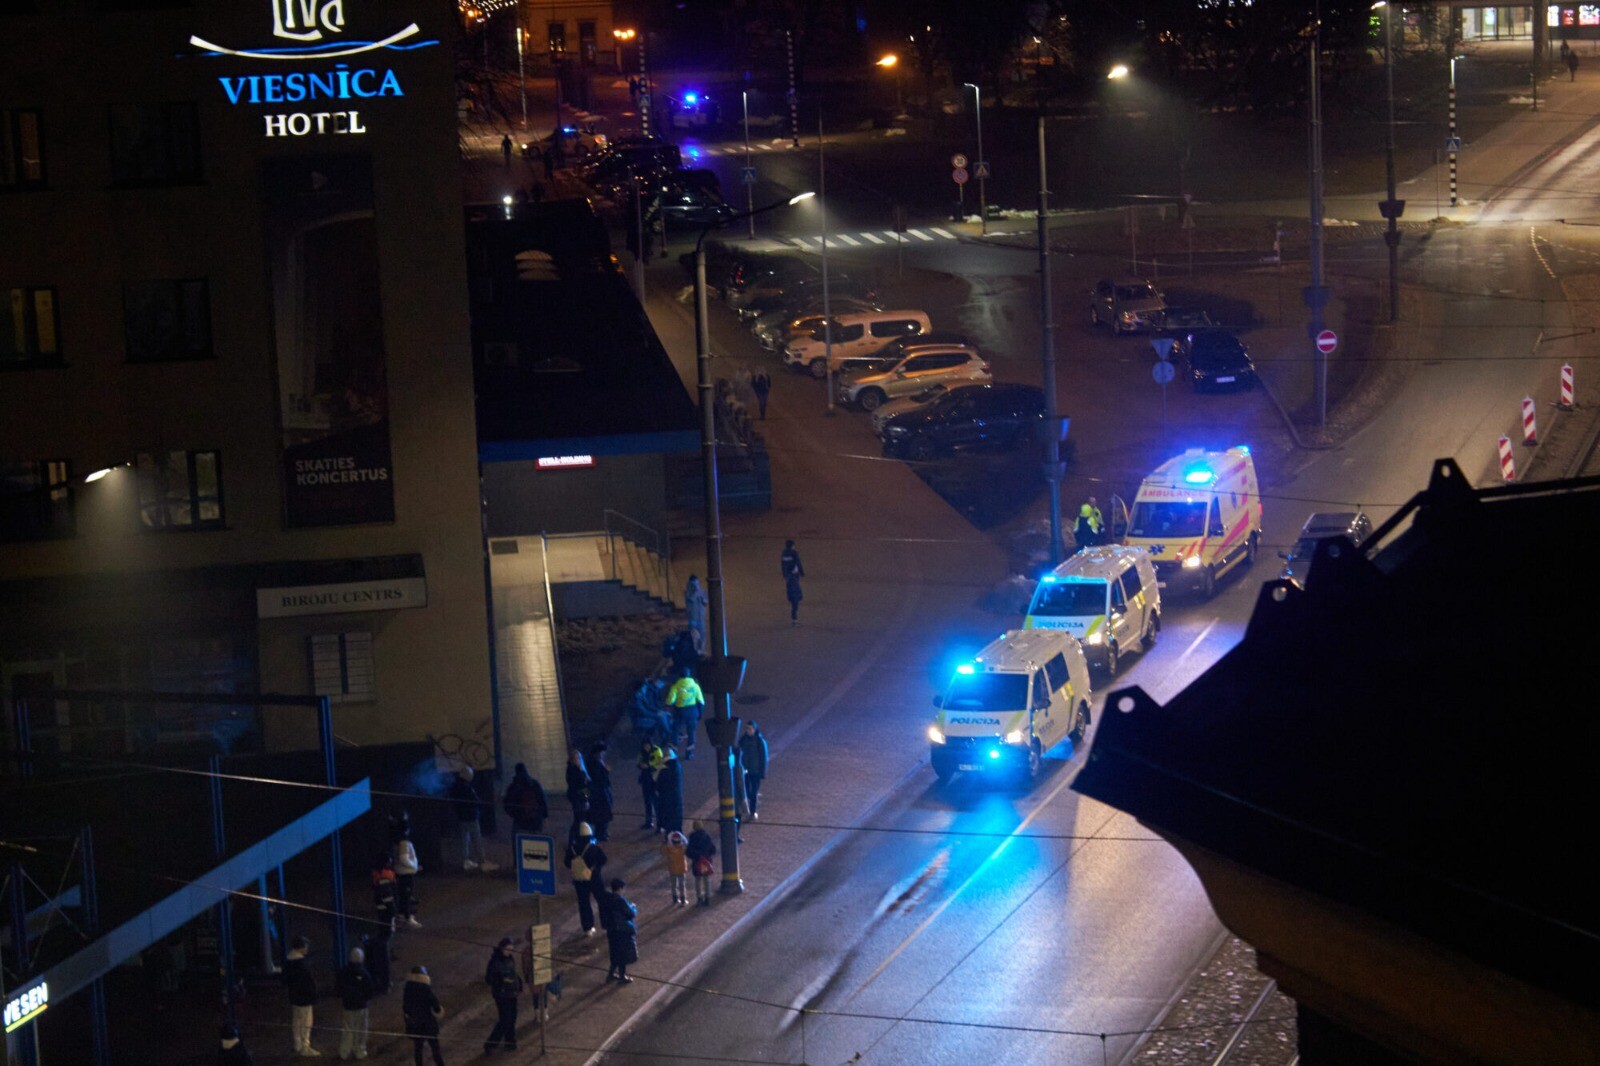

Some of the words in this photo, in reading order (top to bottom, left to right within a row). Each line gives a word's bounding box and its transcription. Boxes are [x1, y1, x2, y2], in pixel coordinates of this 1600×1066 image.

[218, 63, 405, 105] VIESNĪCA
[263, 111, 366, 137] HOTEL
[295, 457, 355, 472] SKATIES
[296, 467, 388, 486] KONCERTUS
[1141, 488, 1205, 498] AMBULANCE
[282, 593, 338, 607] BIROJU
[343, 588, 402, 603] CENTRS
[950, 716, 1001, 726] POLICIJA
